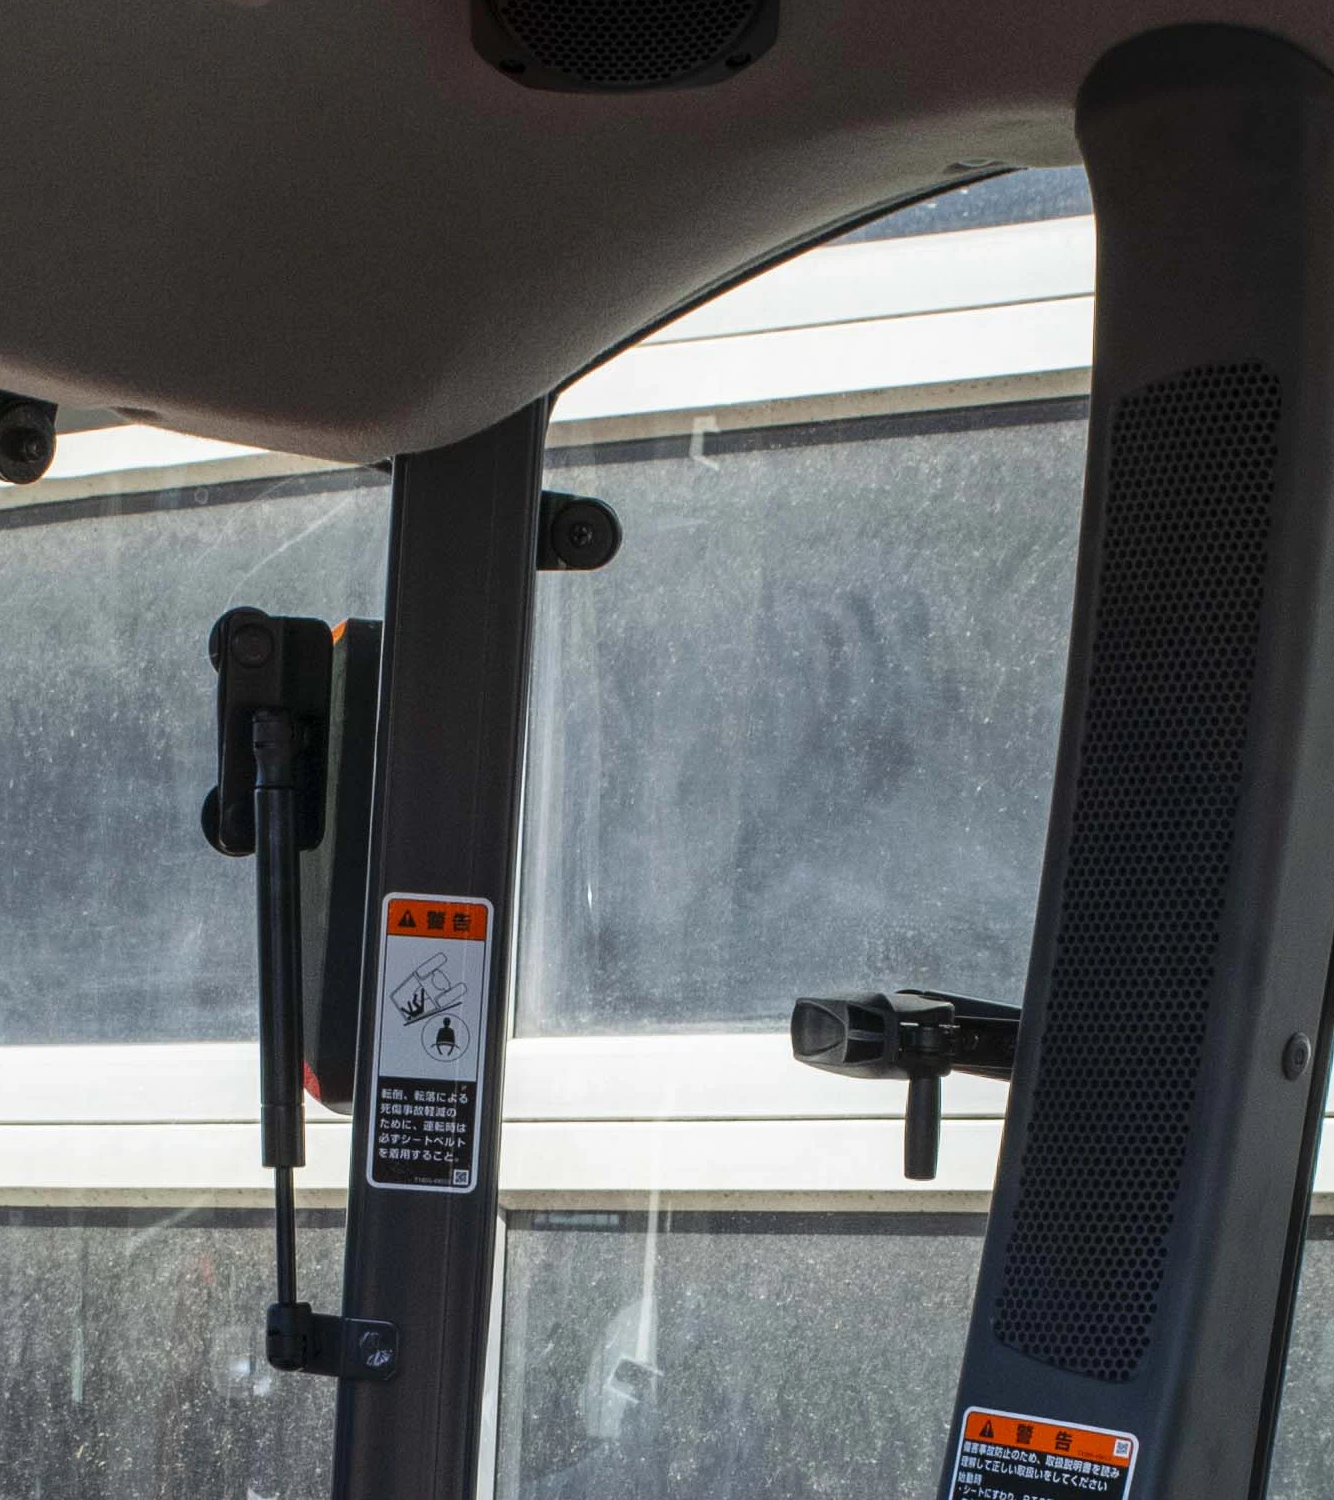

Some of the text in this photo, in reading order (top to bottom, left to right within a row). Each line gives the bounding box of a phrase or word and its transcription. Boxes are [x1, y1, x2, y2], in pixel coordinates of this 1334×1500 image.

[426, 909, 471, 932] 警告
[380, 1087, 468, 1105] 転倒、転落による
[379, 1102, 456, 1119] 死傷事故軽減の
[379, 1116, 467, 1134] ために、運転時は
[378, 1131, 466, 1149] 必ずシートベルト
[378, 1146, 459, 1163] を着用すること。
[1014, 1423, 1074, 1452] 警告
